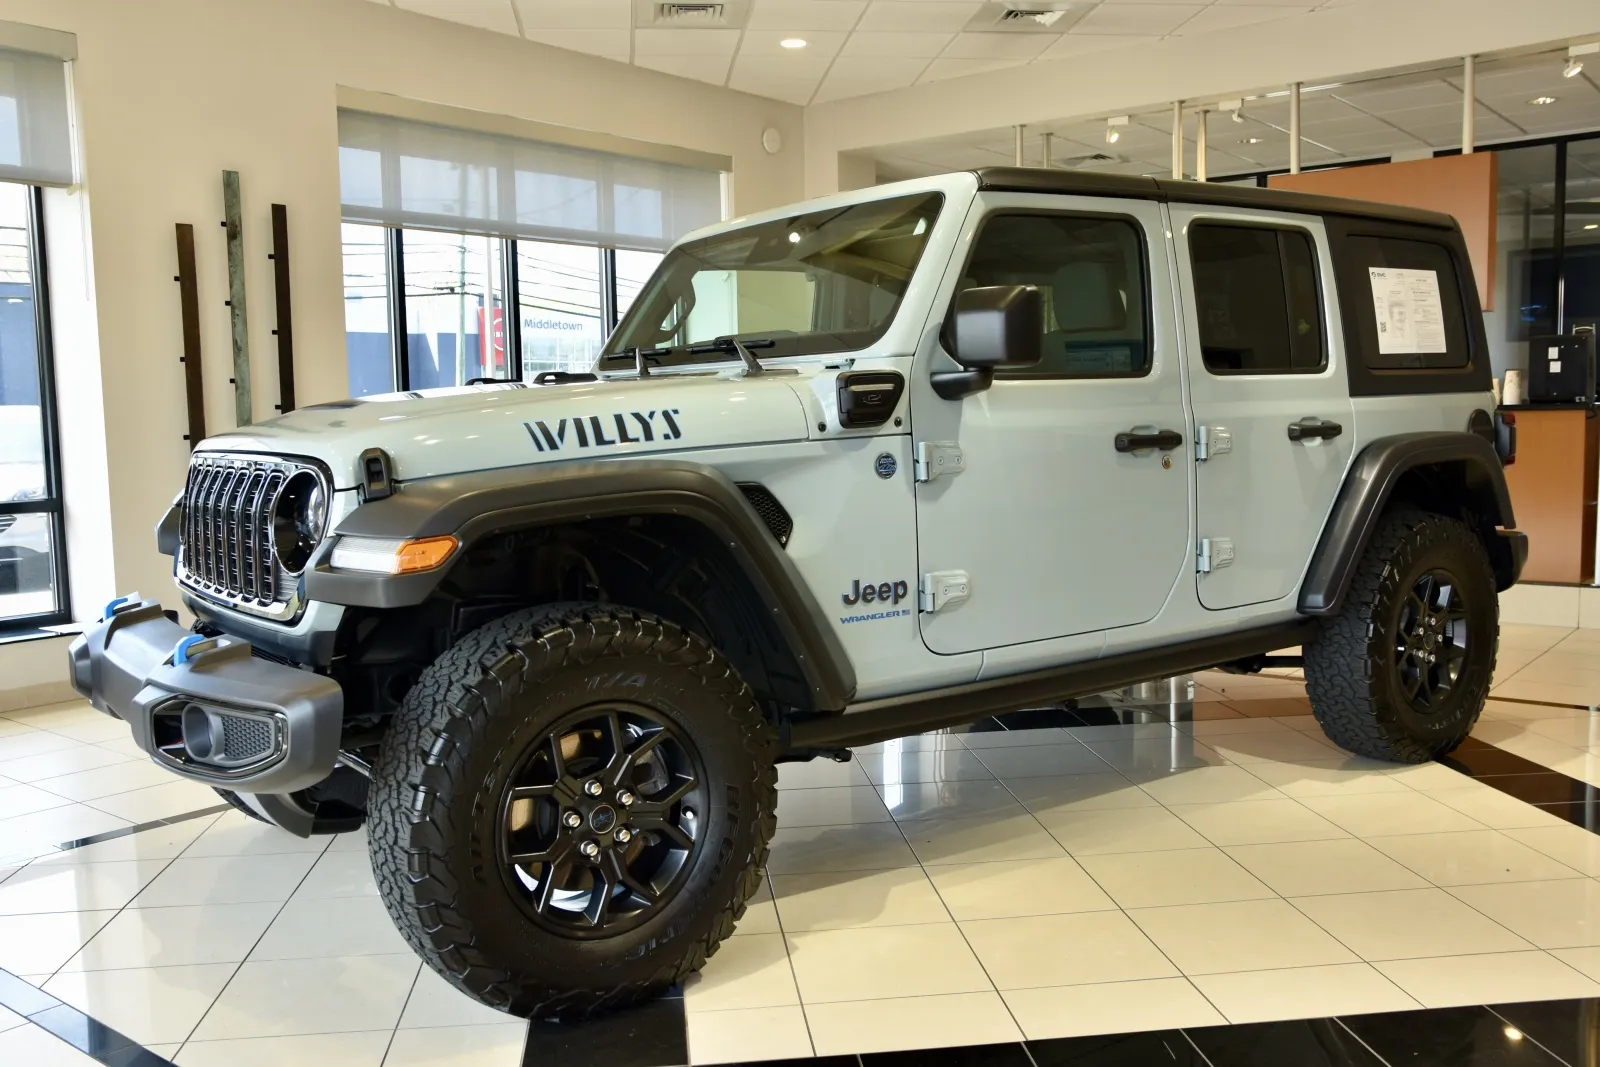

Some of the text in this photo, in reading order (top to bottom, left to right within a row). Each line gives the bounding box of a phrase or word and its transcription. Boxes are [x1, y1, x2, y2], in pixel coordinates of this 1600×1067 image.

[524, 319, 583, 331] Middletown
[523, 408, 682, 452] WILLYS
[842, 578, 908, 606] Jeep
[839, 610, 900, 624] WRANGLER
